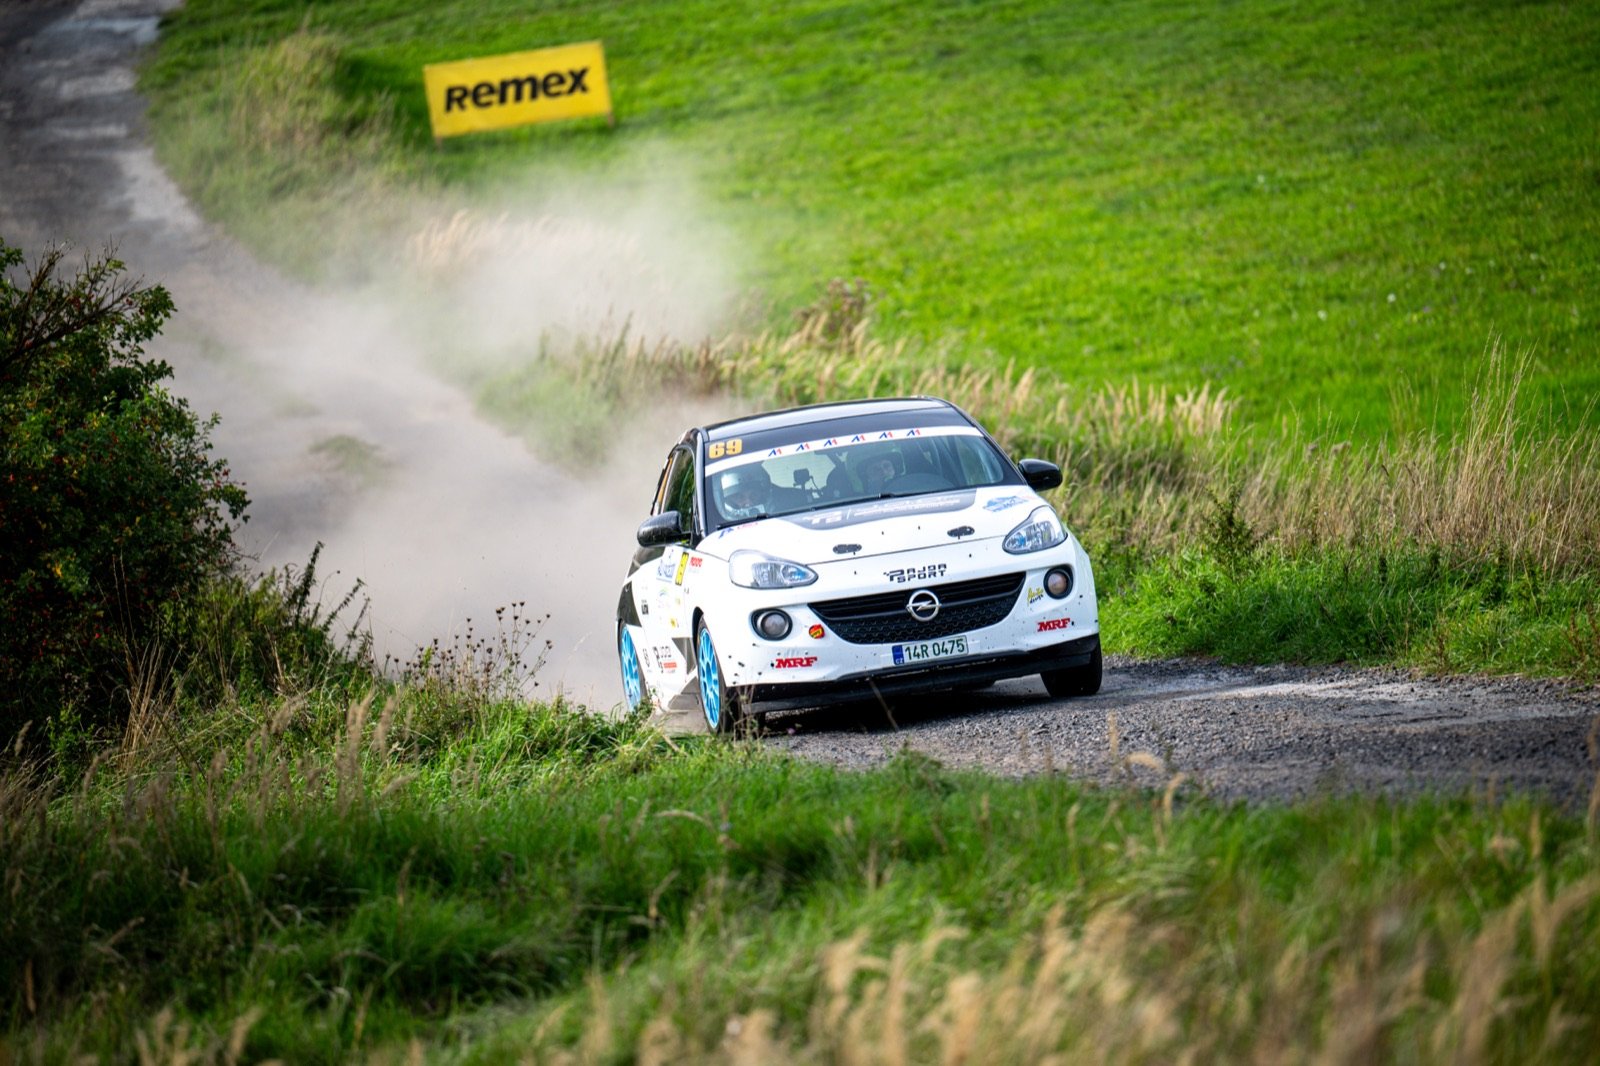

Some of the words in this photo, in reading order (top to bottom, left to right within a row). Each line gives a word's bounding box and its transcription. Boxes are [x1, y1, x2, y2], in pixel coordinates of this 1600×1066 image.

[708, 438, 743, 459] 69
[897, 570, 946, 583] SPORT
[1037, 617, 1071, 632] MRF
[905, 644, 930, 660] 14R
[932, 638, 965, 656] 0475
[775, 656, 818, 669] MRF
